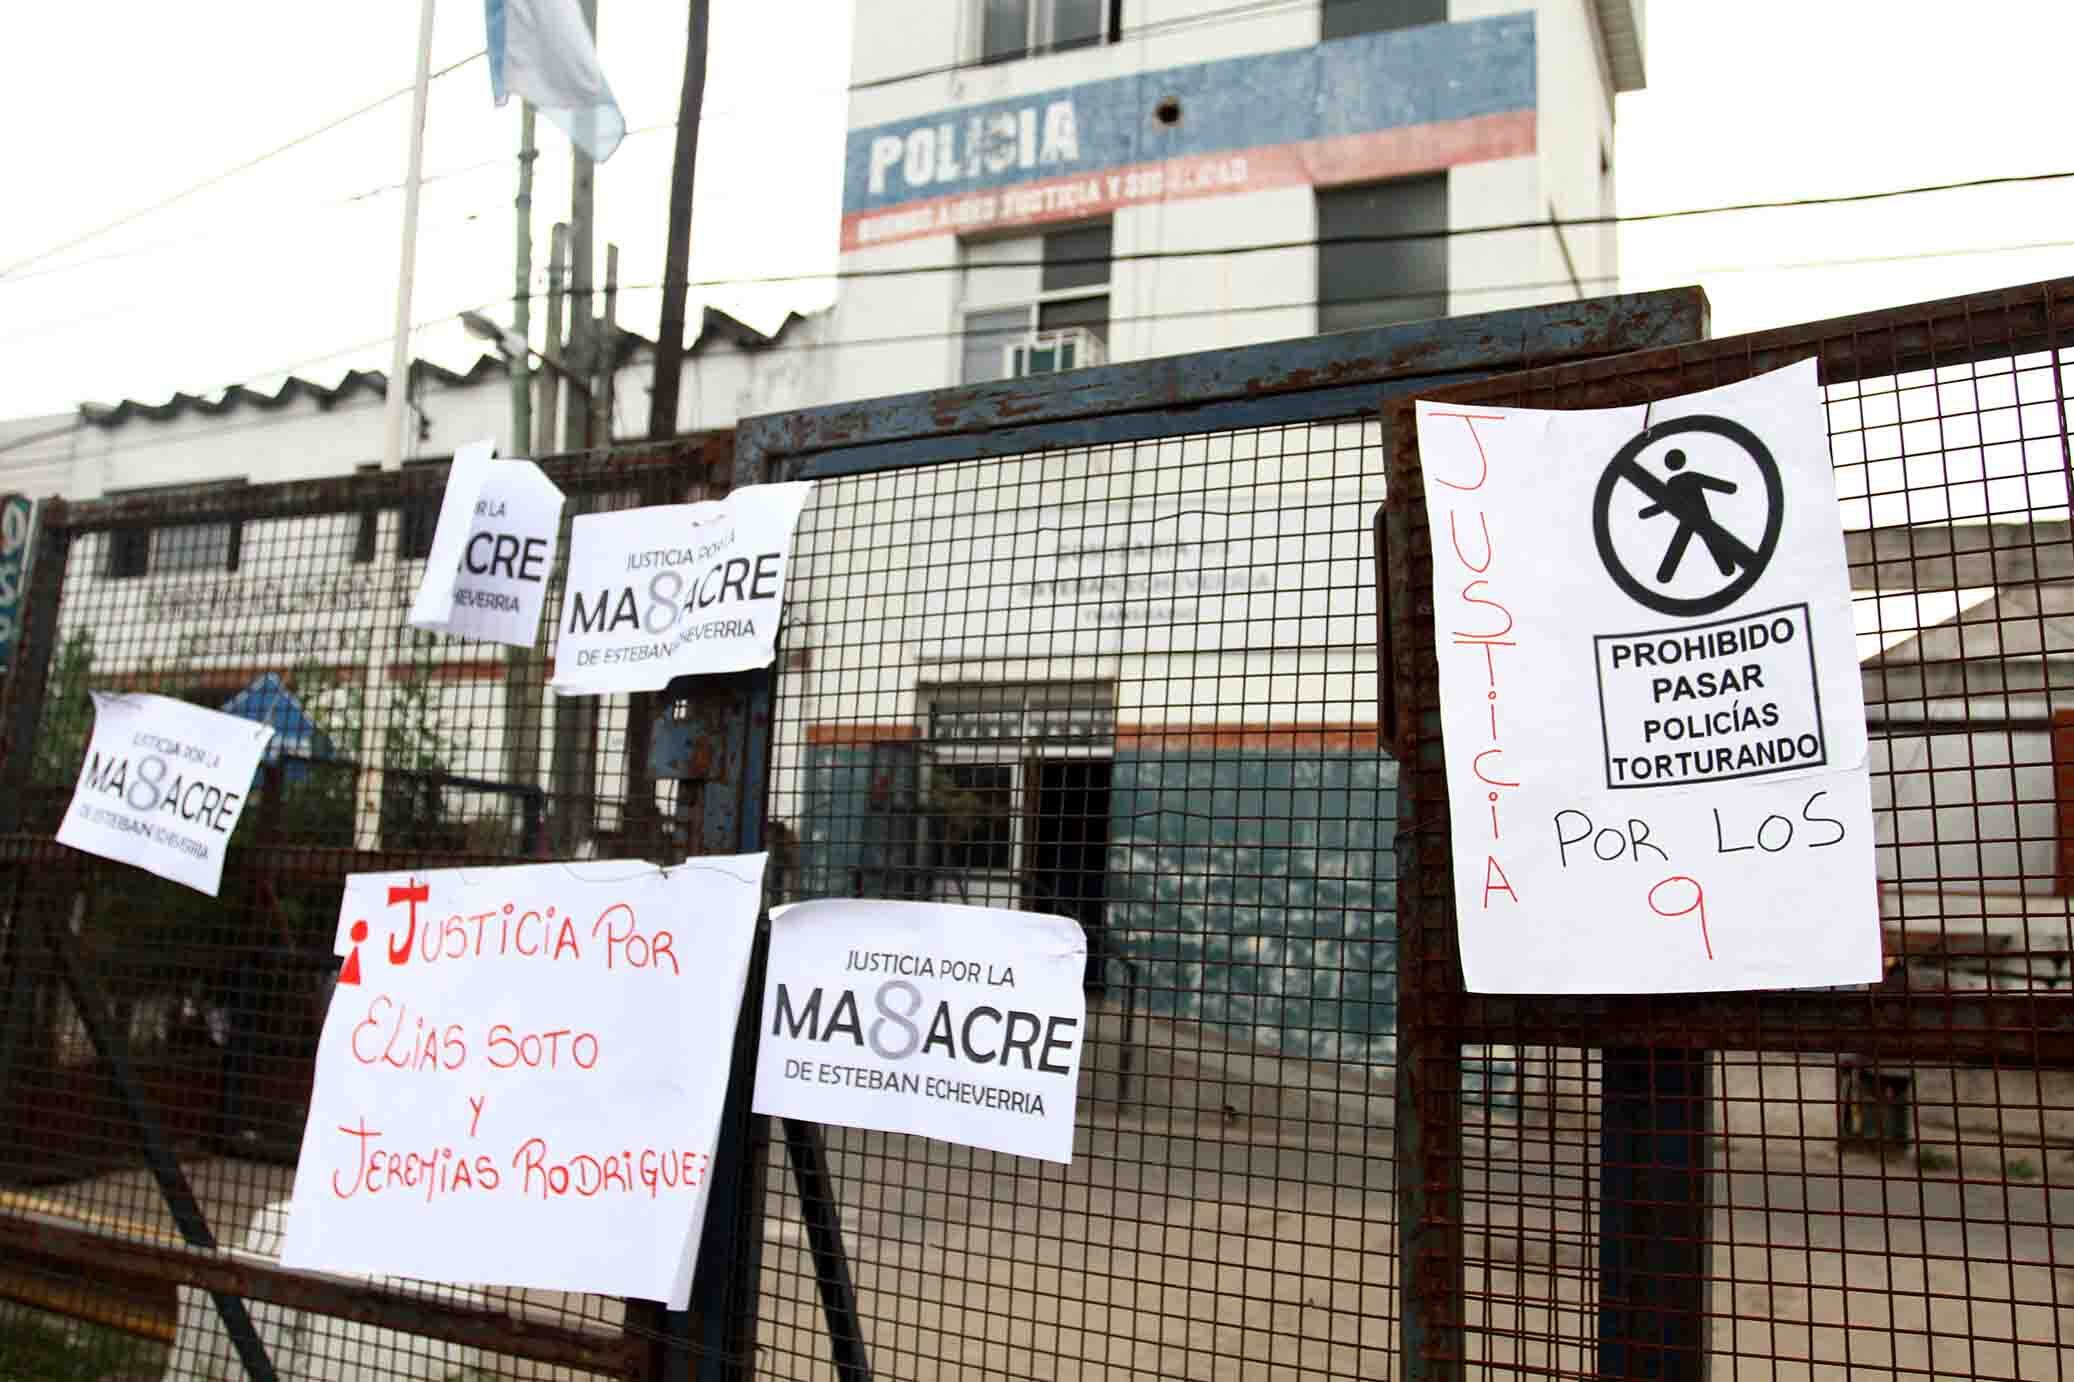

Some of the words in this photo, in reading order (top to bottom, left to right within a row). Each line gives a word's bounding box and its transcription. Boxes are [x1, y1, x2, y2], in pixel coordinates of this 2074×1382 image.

[868, 100, 1080, 194] POLICIA
[457, 531, 548, 583] CRE
[627, 547, 694, 572] JUSTICIA
[576, 649, 602, 667] DE
[603, 642, 672, 664] ESTEBAN
[1611, 616, 1796, 669] PROHIBIDO
[1652, 663, 1765, 704] PASAR
[1643, 700, 1780, 744] POLICÍAS
[1613, 732, 1819, 781] TORTURANDO
[1554, 809, 1668, 867] POR
[1714, 791, 1845, 854] LOS
[591, 903, 680, 976] POR
[1648, 876, 1713, 960] 9
[845, 950, 935, 977] JUSTICIA
[940, 959, 981, 984] POR
[987, 965, 1015, 988] LA
[487, 1023, 599, 1070] SOTO
[772, 979, 1078, 1075] MA8ACRE
[784, 1058, 813, 1081] DE
[818, 1063, 920, 1095] ESTEBAN
[925, 1076, 1045, 1116] ECHEVERRIA
